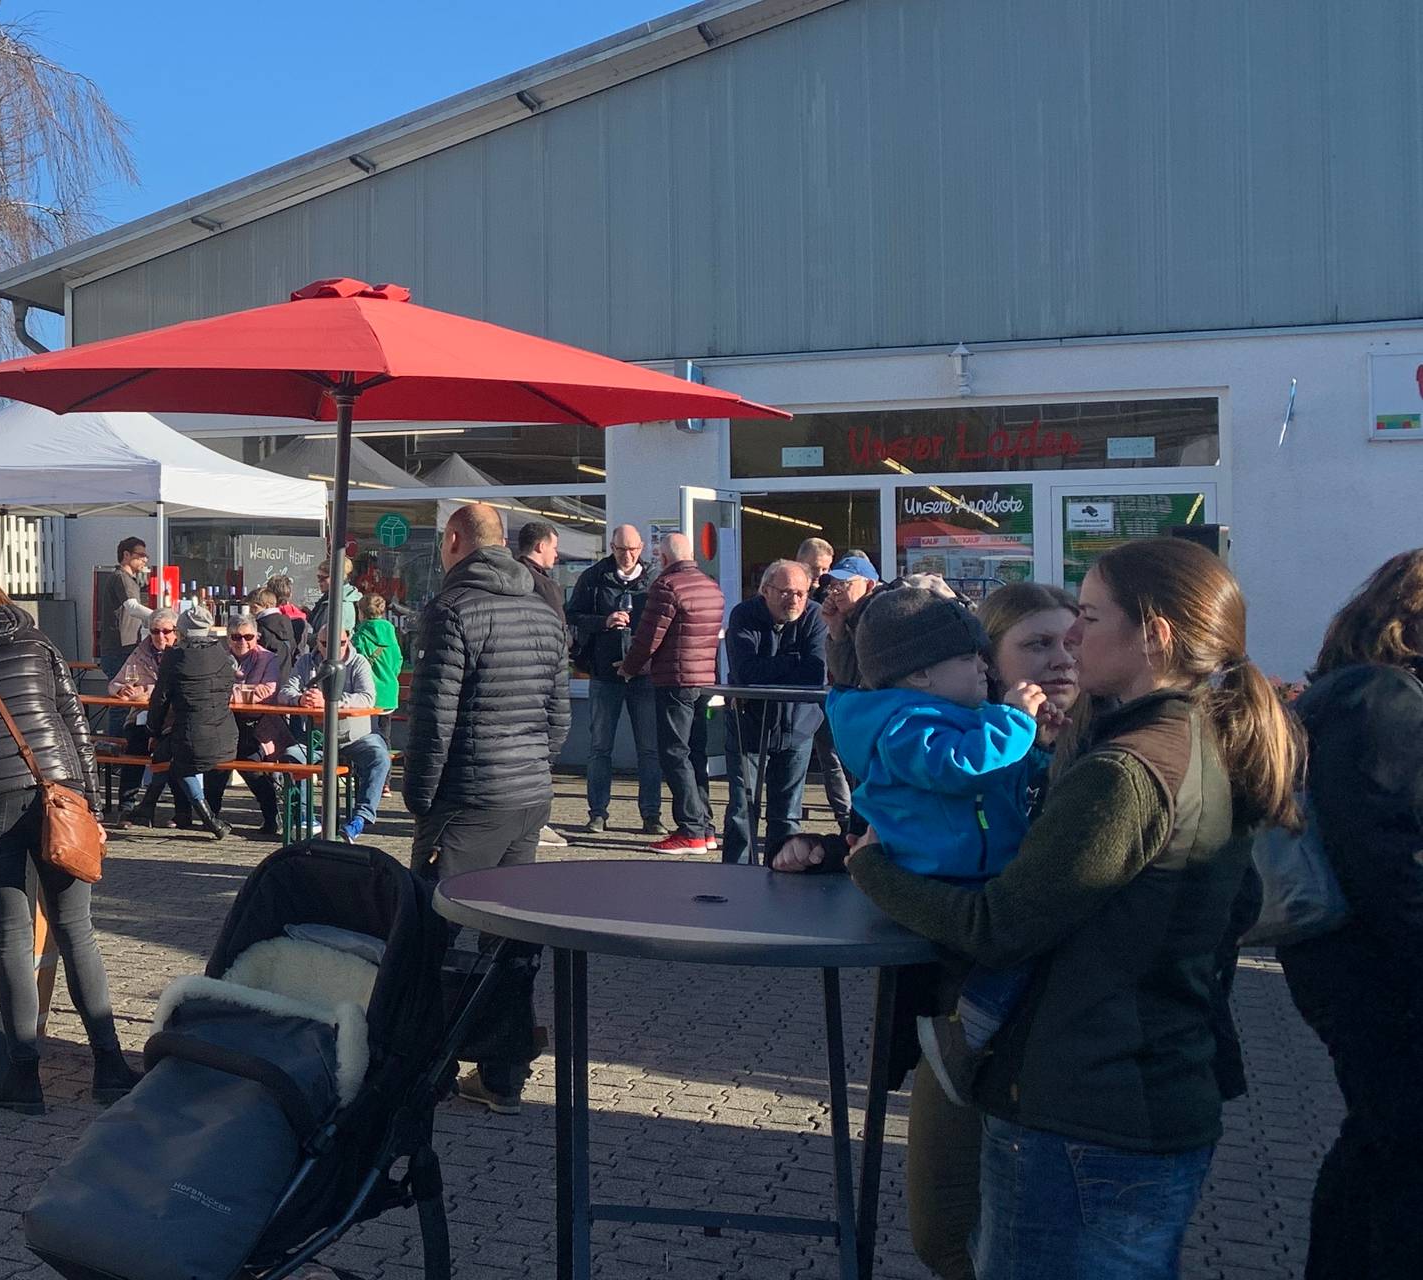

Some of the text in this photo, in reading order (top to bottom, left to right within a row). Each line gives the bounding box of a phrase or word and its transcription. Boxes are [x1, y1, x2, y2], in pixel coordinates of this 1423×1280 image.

[848, 417, 1082, 465] Unser Laden
[904, 491, 1024, 520] Unsere Angebote
[249, 541, 288, 561] WEINGUT
